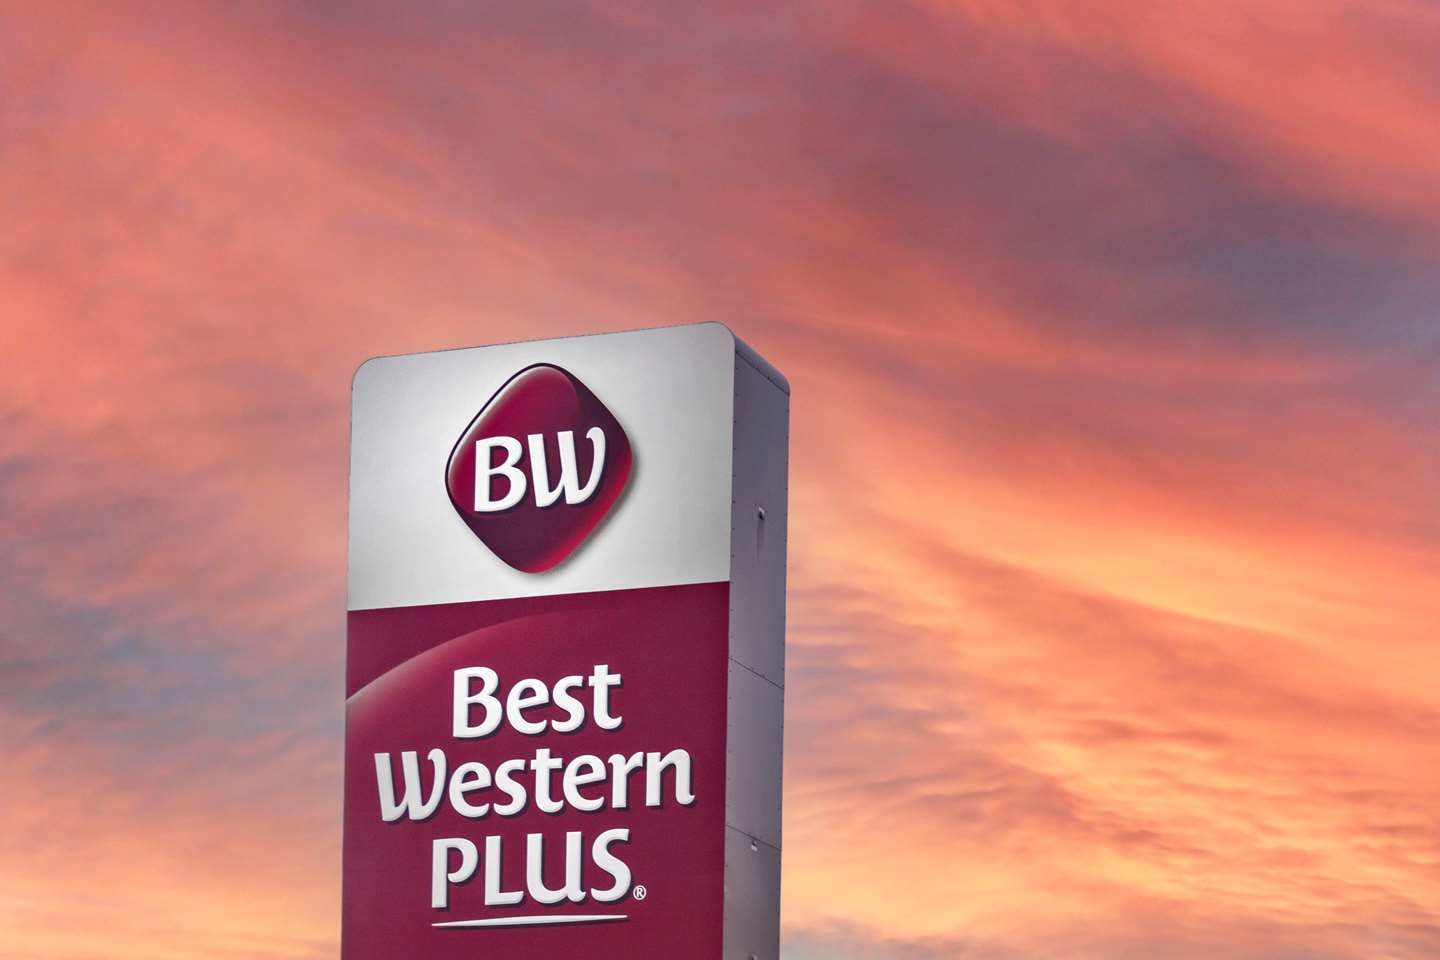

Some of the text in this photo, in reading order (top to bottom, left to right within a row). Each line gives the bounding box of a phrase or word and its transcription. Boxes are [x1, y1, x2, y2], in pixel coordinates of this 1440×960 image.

[473, 426, 606, 513] BW
[452, 664, 623, 740] Best
[373, 747, 695, 822] Western
